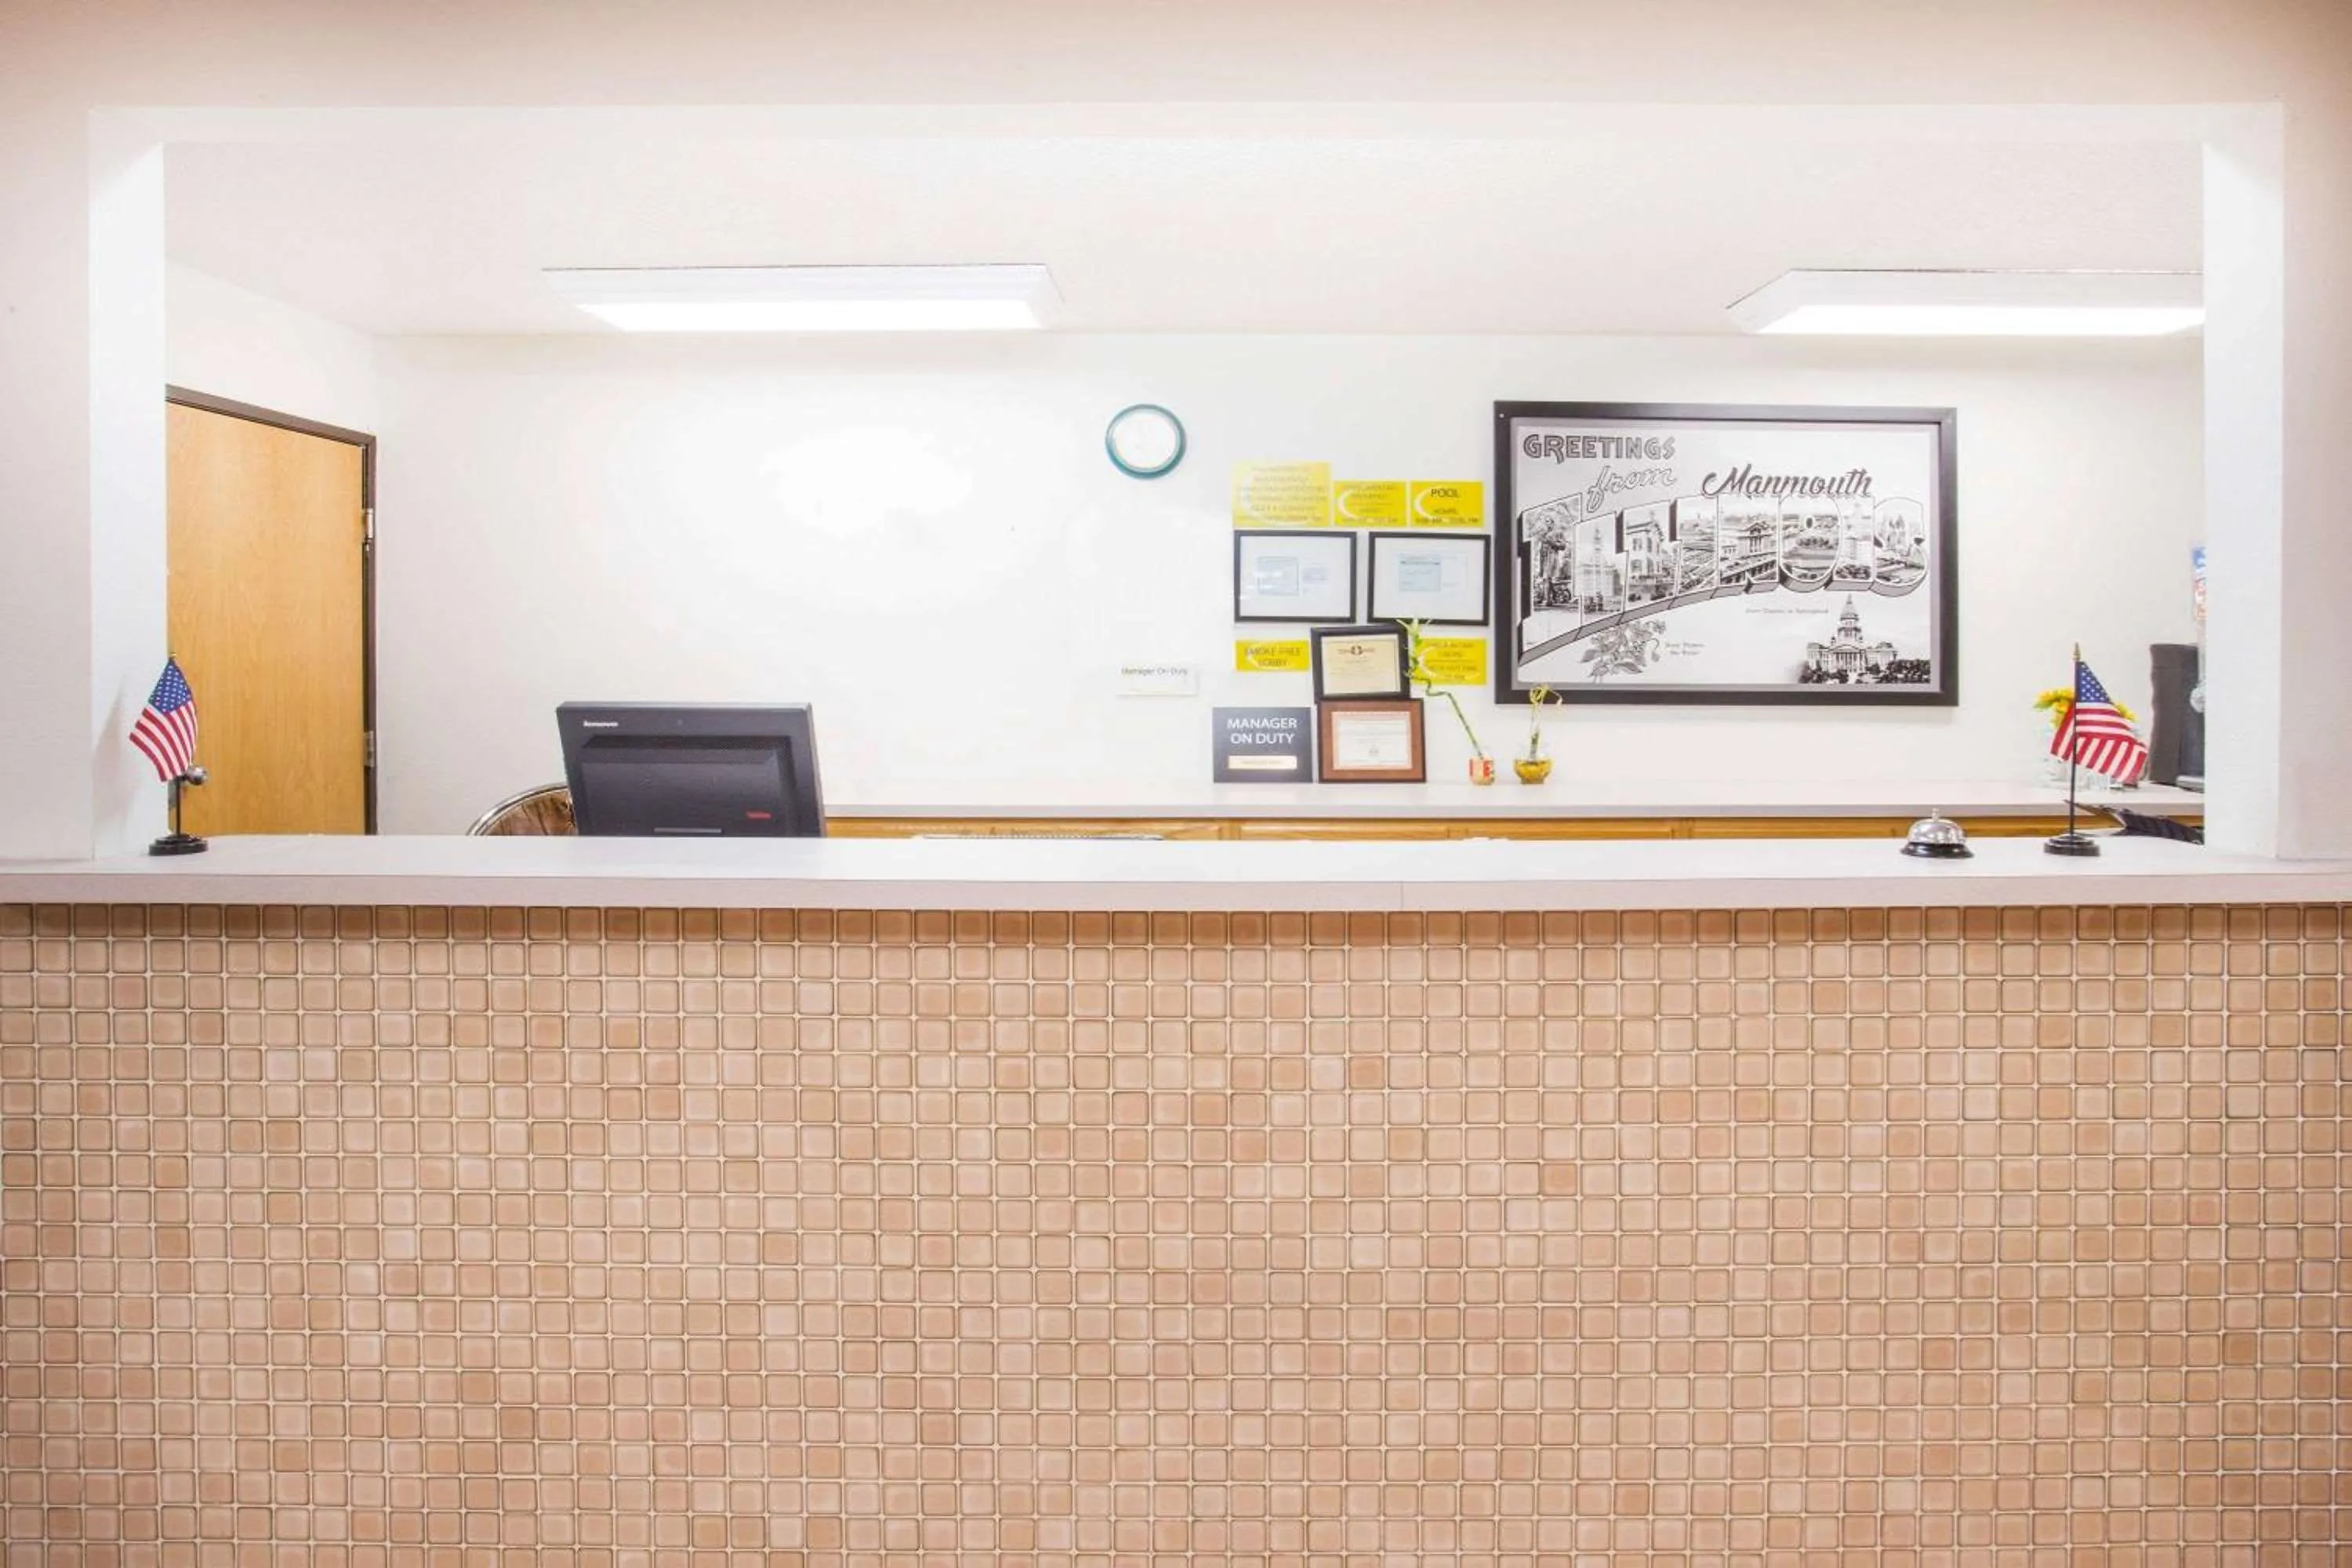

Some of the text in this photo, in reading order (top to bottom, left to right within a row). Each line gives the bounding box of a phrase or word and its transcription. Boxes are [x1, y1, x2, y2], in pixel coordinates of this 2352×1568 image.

[1523, 434, 1676, 464] GREETINGS
[1587, 466, 1677, 514] from
[1702, 463, 1873, 497] Manmouth
[1430, 488, 1461, 498] POOL
[1516, 492, 1929, 666] ILLINOIS
[1121, 667, 1155, 677] Manager
[1171, 666, 1188, 677] Duty
[1227, 717, 1297, 729] MANAGER
[1230, 733, 1294, 744] ON DUTY
